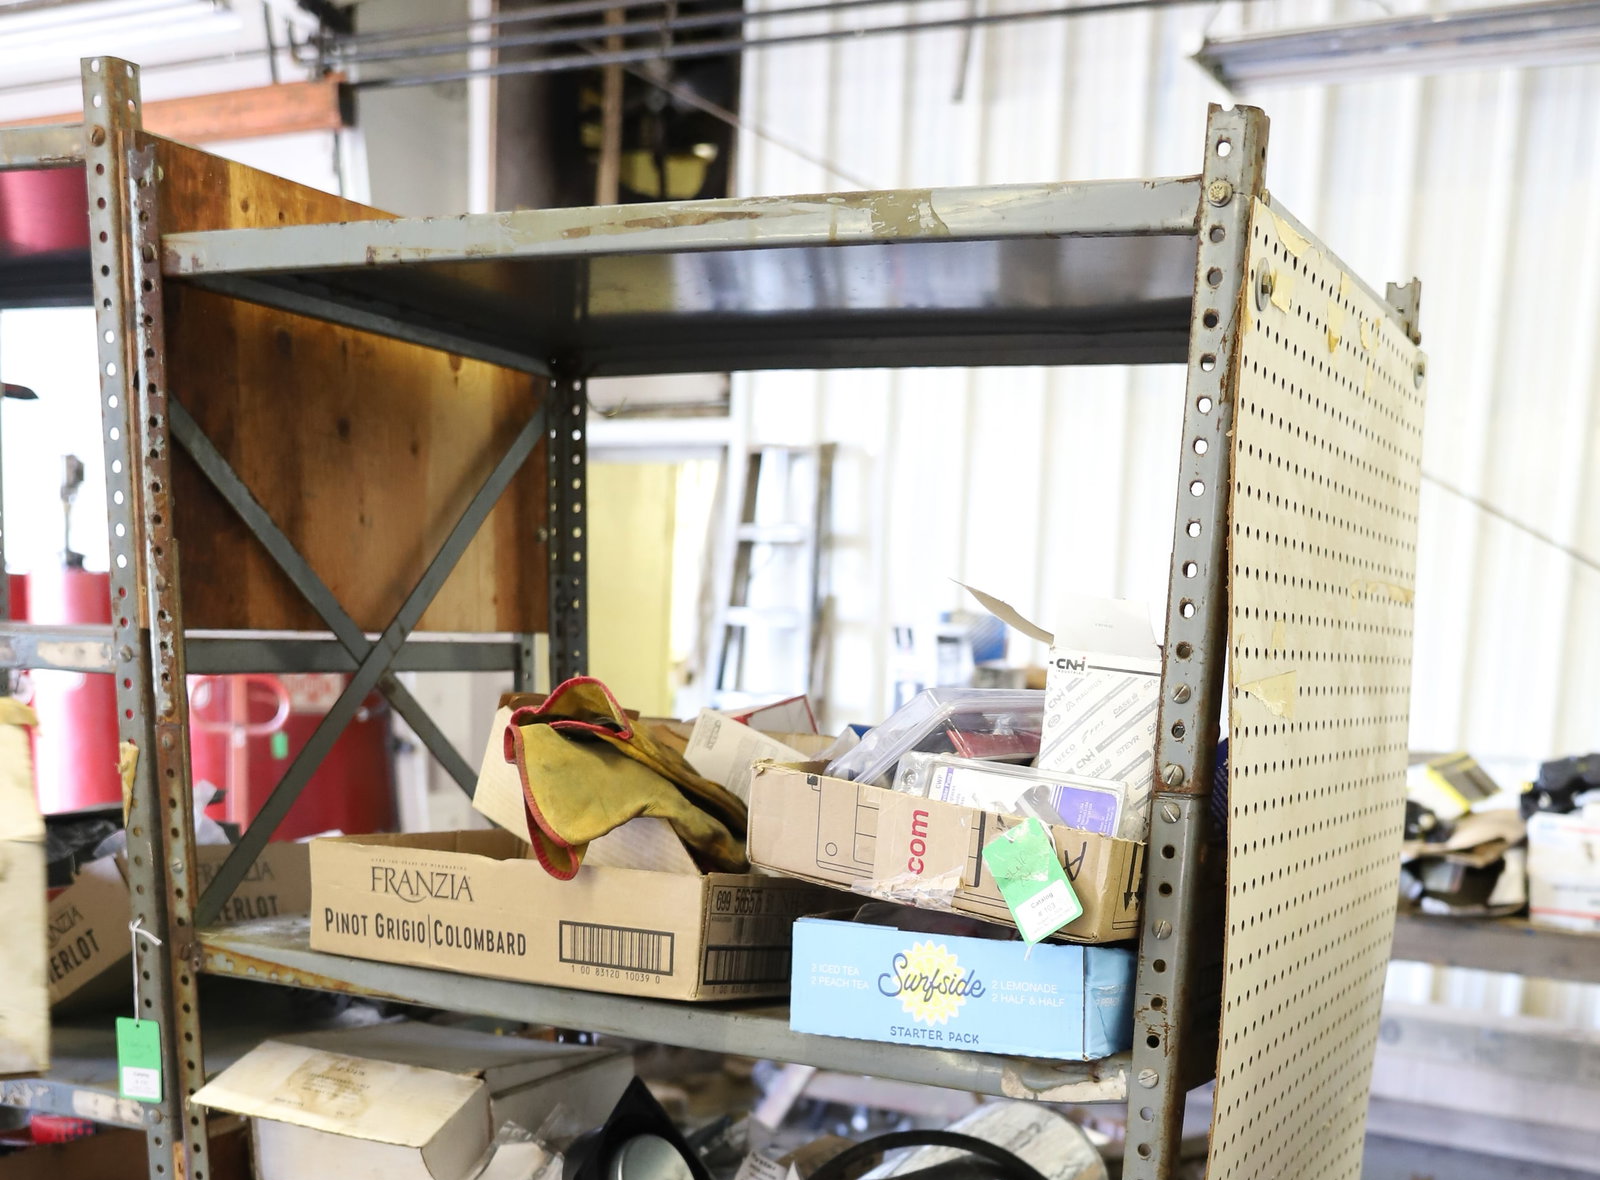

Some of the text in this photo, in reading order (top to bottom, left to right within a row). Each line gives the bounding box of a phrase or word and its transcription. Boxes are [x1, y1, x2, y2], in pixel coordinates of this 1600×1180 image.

[1116, 735, 1140, 756] STEYR
[370, 865, 474, 903] FRANZIA
[216, 895, 279, 923] ERLOT
[324, 908, 368, 937] PINOT
[818, 963, 840, 974] ICED
[842, 965, 861, 976] TEA
[877, 952, 986, 1003] Surfside
[819, 976, 847, 988] PEACH
[849, 979, 870, 990] TEA
[1000, 981, 1058, 995] LEMONADE
[1000, 994, 1025, 1005] HALF
[1039, 997, 1065, 1008] HALF
[890, 1026, 980, 1045] STARTER PACK
